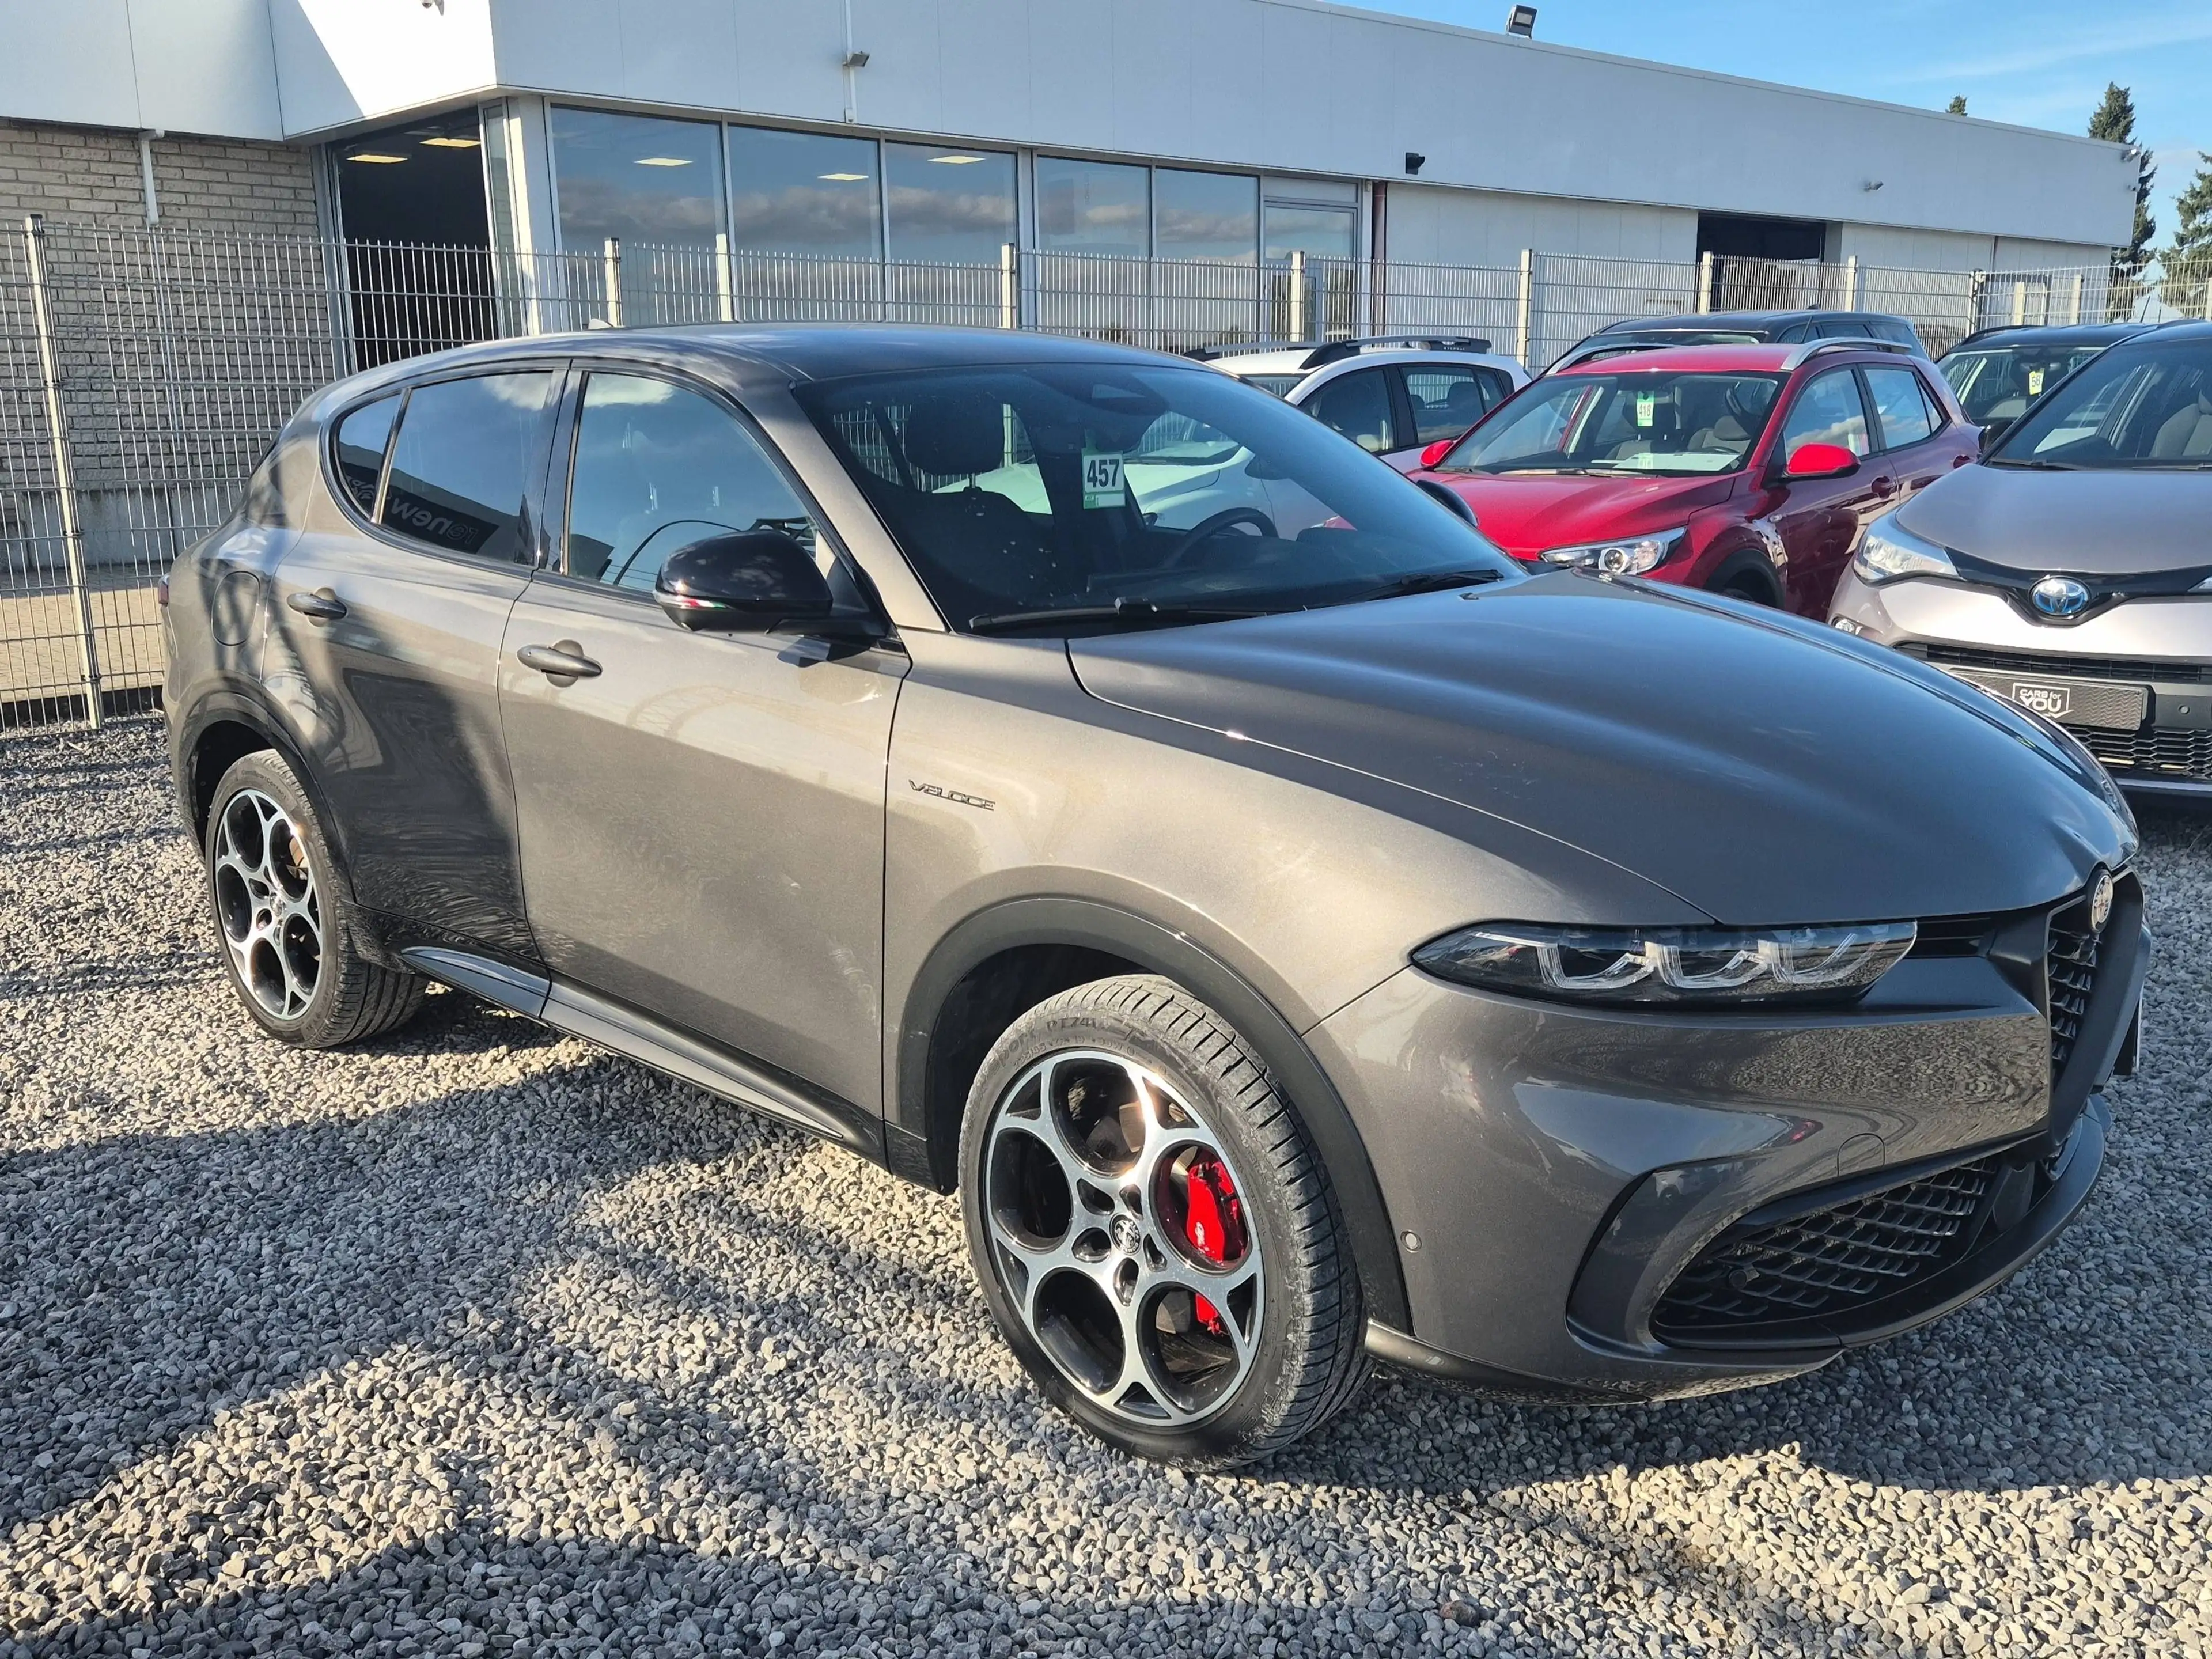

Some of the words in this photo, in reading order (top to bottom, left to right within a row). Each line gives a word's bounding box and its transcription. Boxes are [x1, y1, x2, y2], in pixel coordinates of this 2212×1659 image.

[1639, 404, 1652, 417] 418
[1087, 459, 1120, 487] 457
[2020, 688, 2048, 698] CARS
[2050, 691, 2062, 700] for
[2020, 695, 2062, 713] YOU
[908, 779, 995, 811] VELOCE
